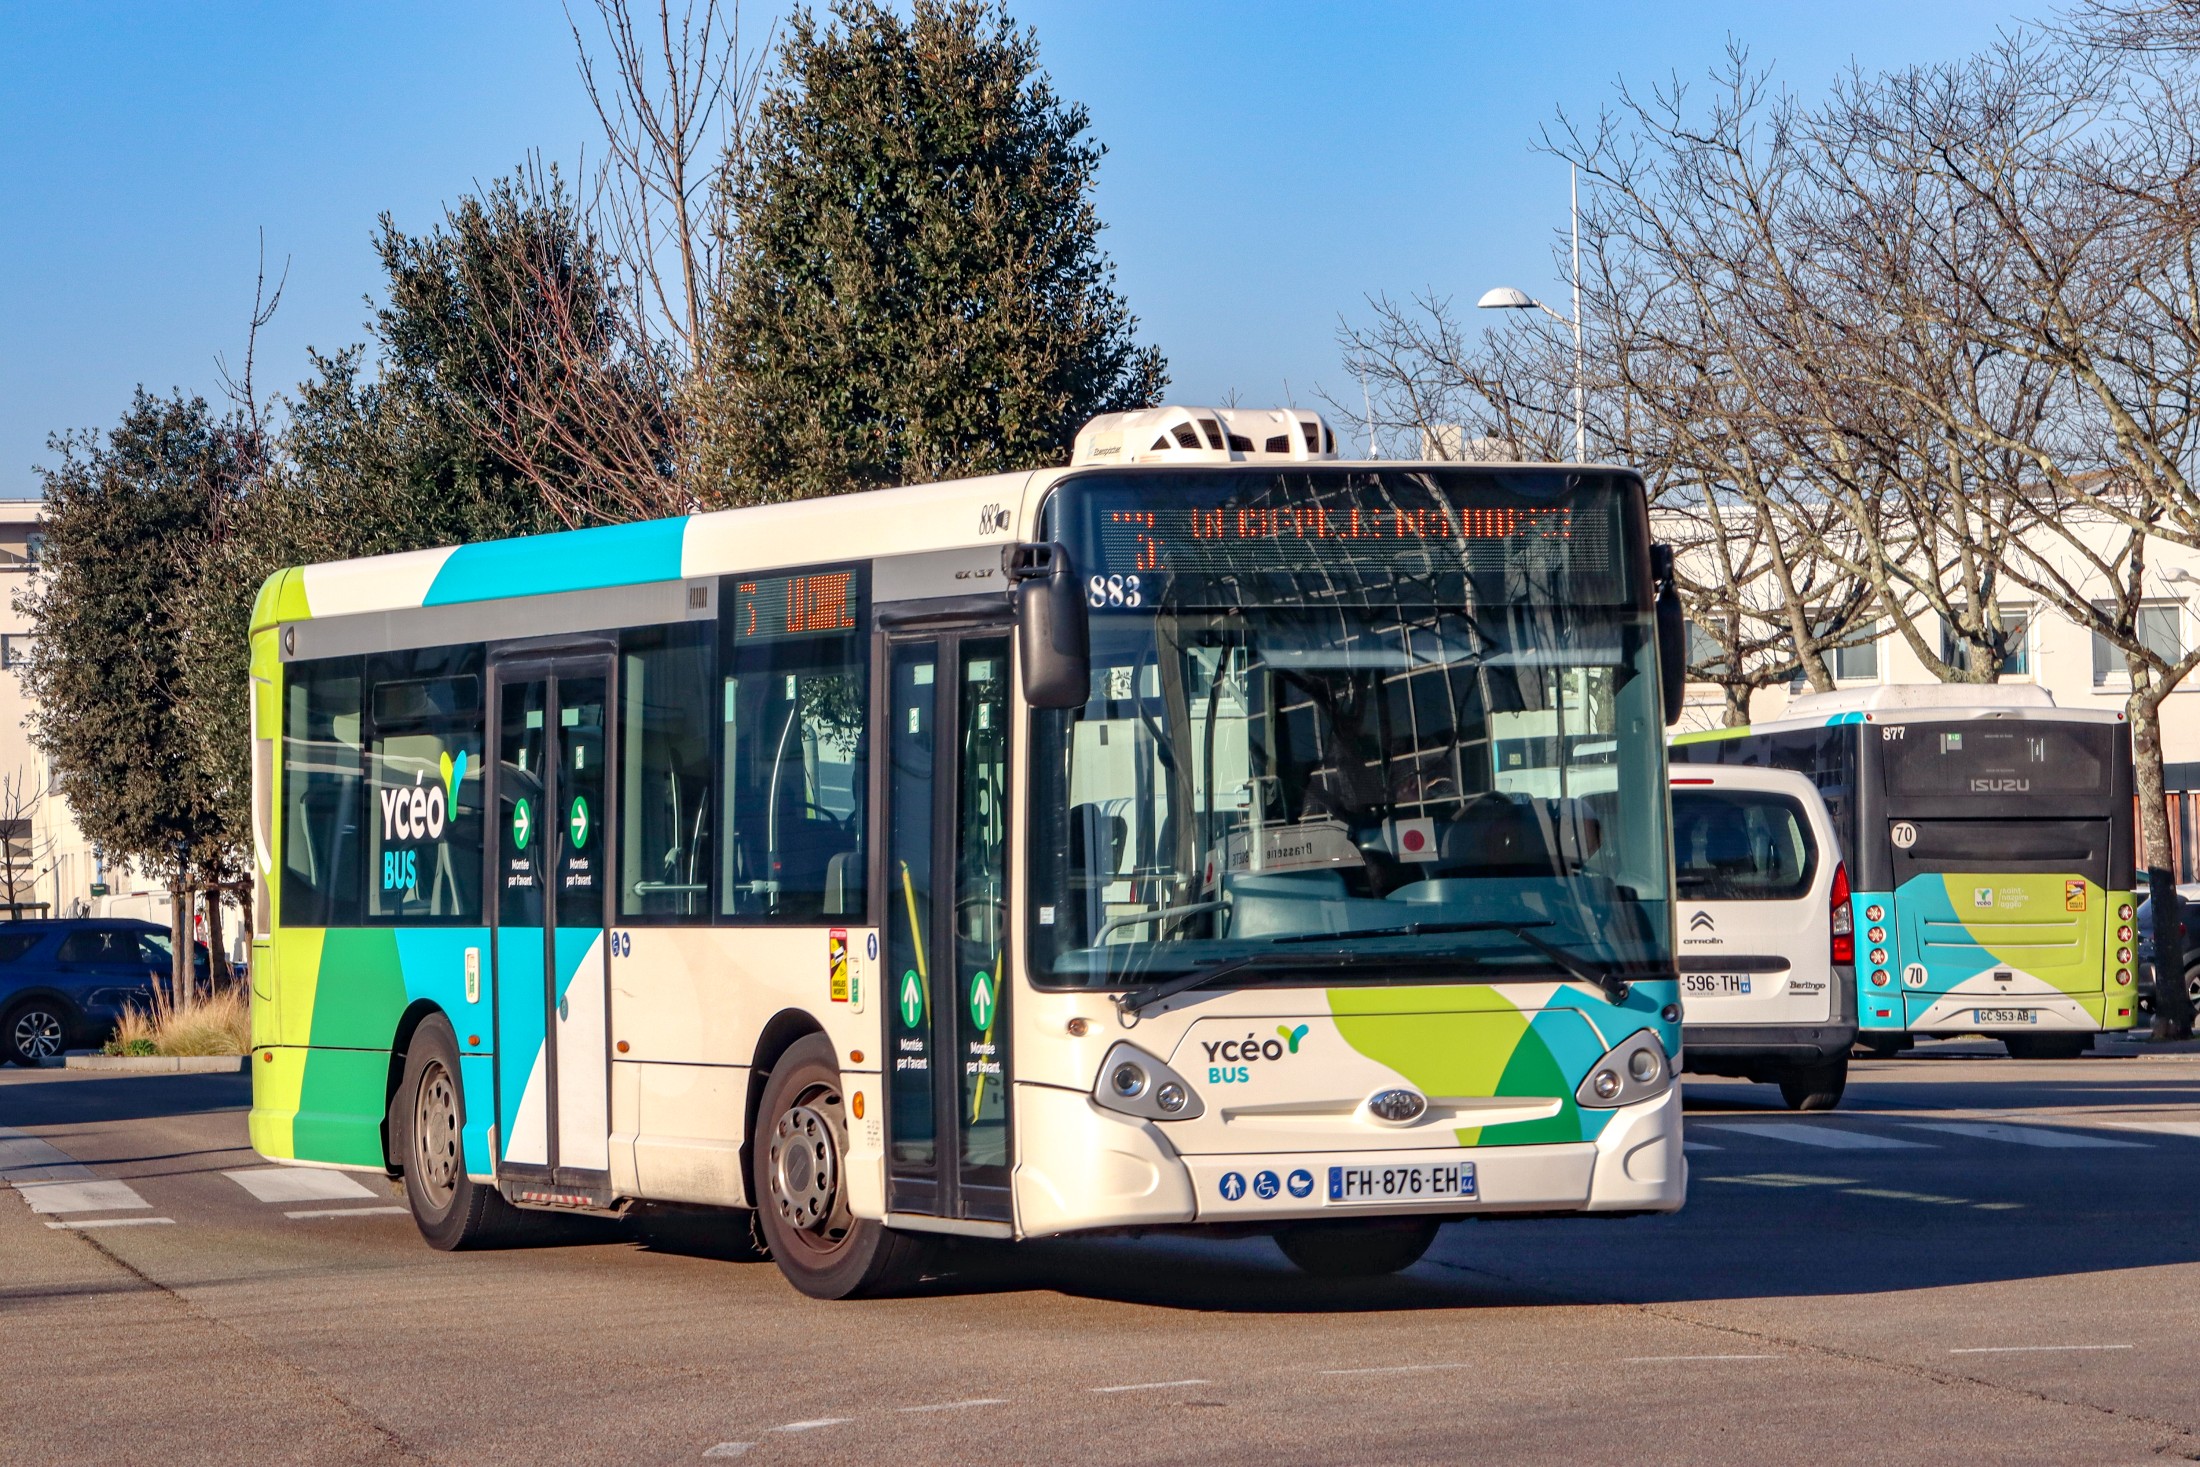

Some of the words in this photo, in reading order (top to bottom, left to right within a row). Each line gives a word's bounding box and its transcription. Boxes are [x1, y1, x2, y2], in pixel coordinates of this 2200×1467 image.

[1090, 574, 1141, 607] 883
[1883, 726, 1905, 740] 877
[1971, 779, 2029, 791] ISUZU
[1896, 827, 1912, 842] 70
[384, 850, 416, 889] BUS
[511, 858, 529, 870] Montée
[570, 857, 588, 869] Montée
[508, 876, 517, 888] par
[566, 876, 575, 888] par
[1908, 967, 1923, 984] 70
[1790, 981, 1826, 991] Berlingo
[901, 1038, 923, 1051] Montée
[970, 1042, 995, 1055] Montée
[897, 1058, 908, 1071] par
[908, 1056, 928, 1069] l'avant
[966, 1062, 978, 1075] par
[1209, 1067, 1249, 1084] BUS
[1346, 1167, 1458, 1196] FH-876-EH
[1462, 1178, 1473, 1192] 44
